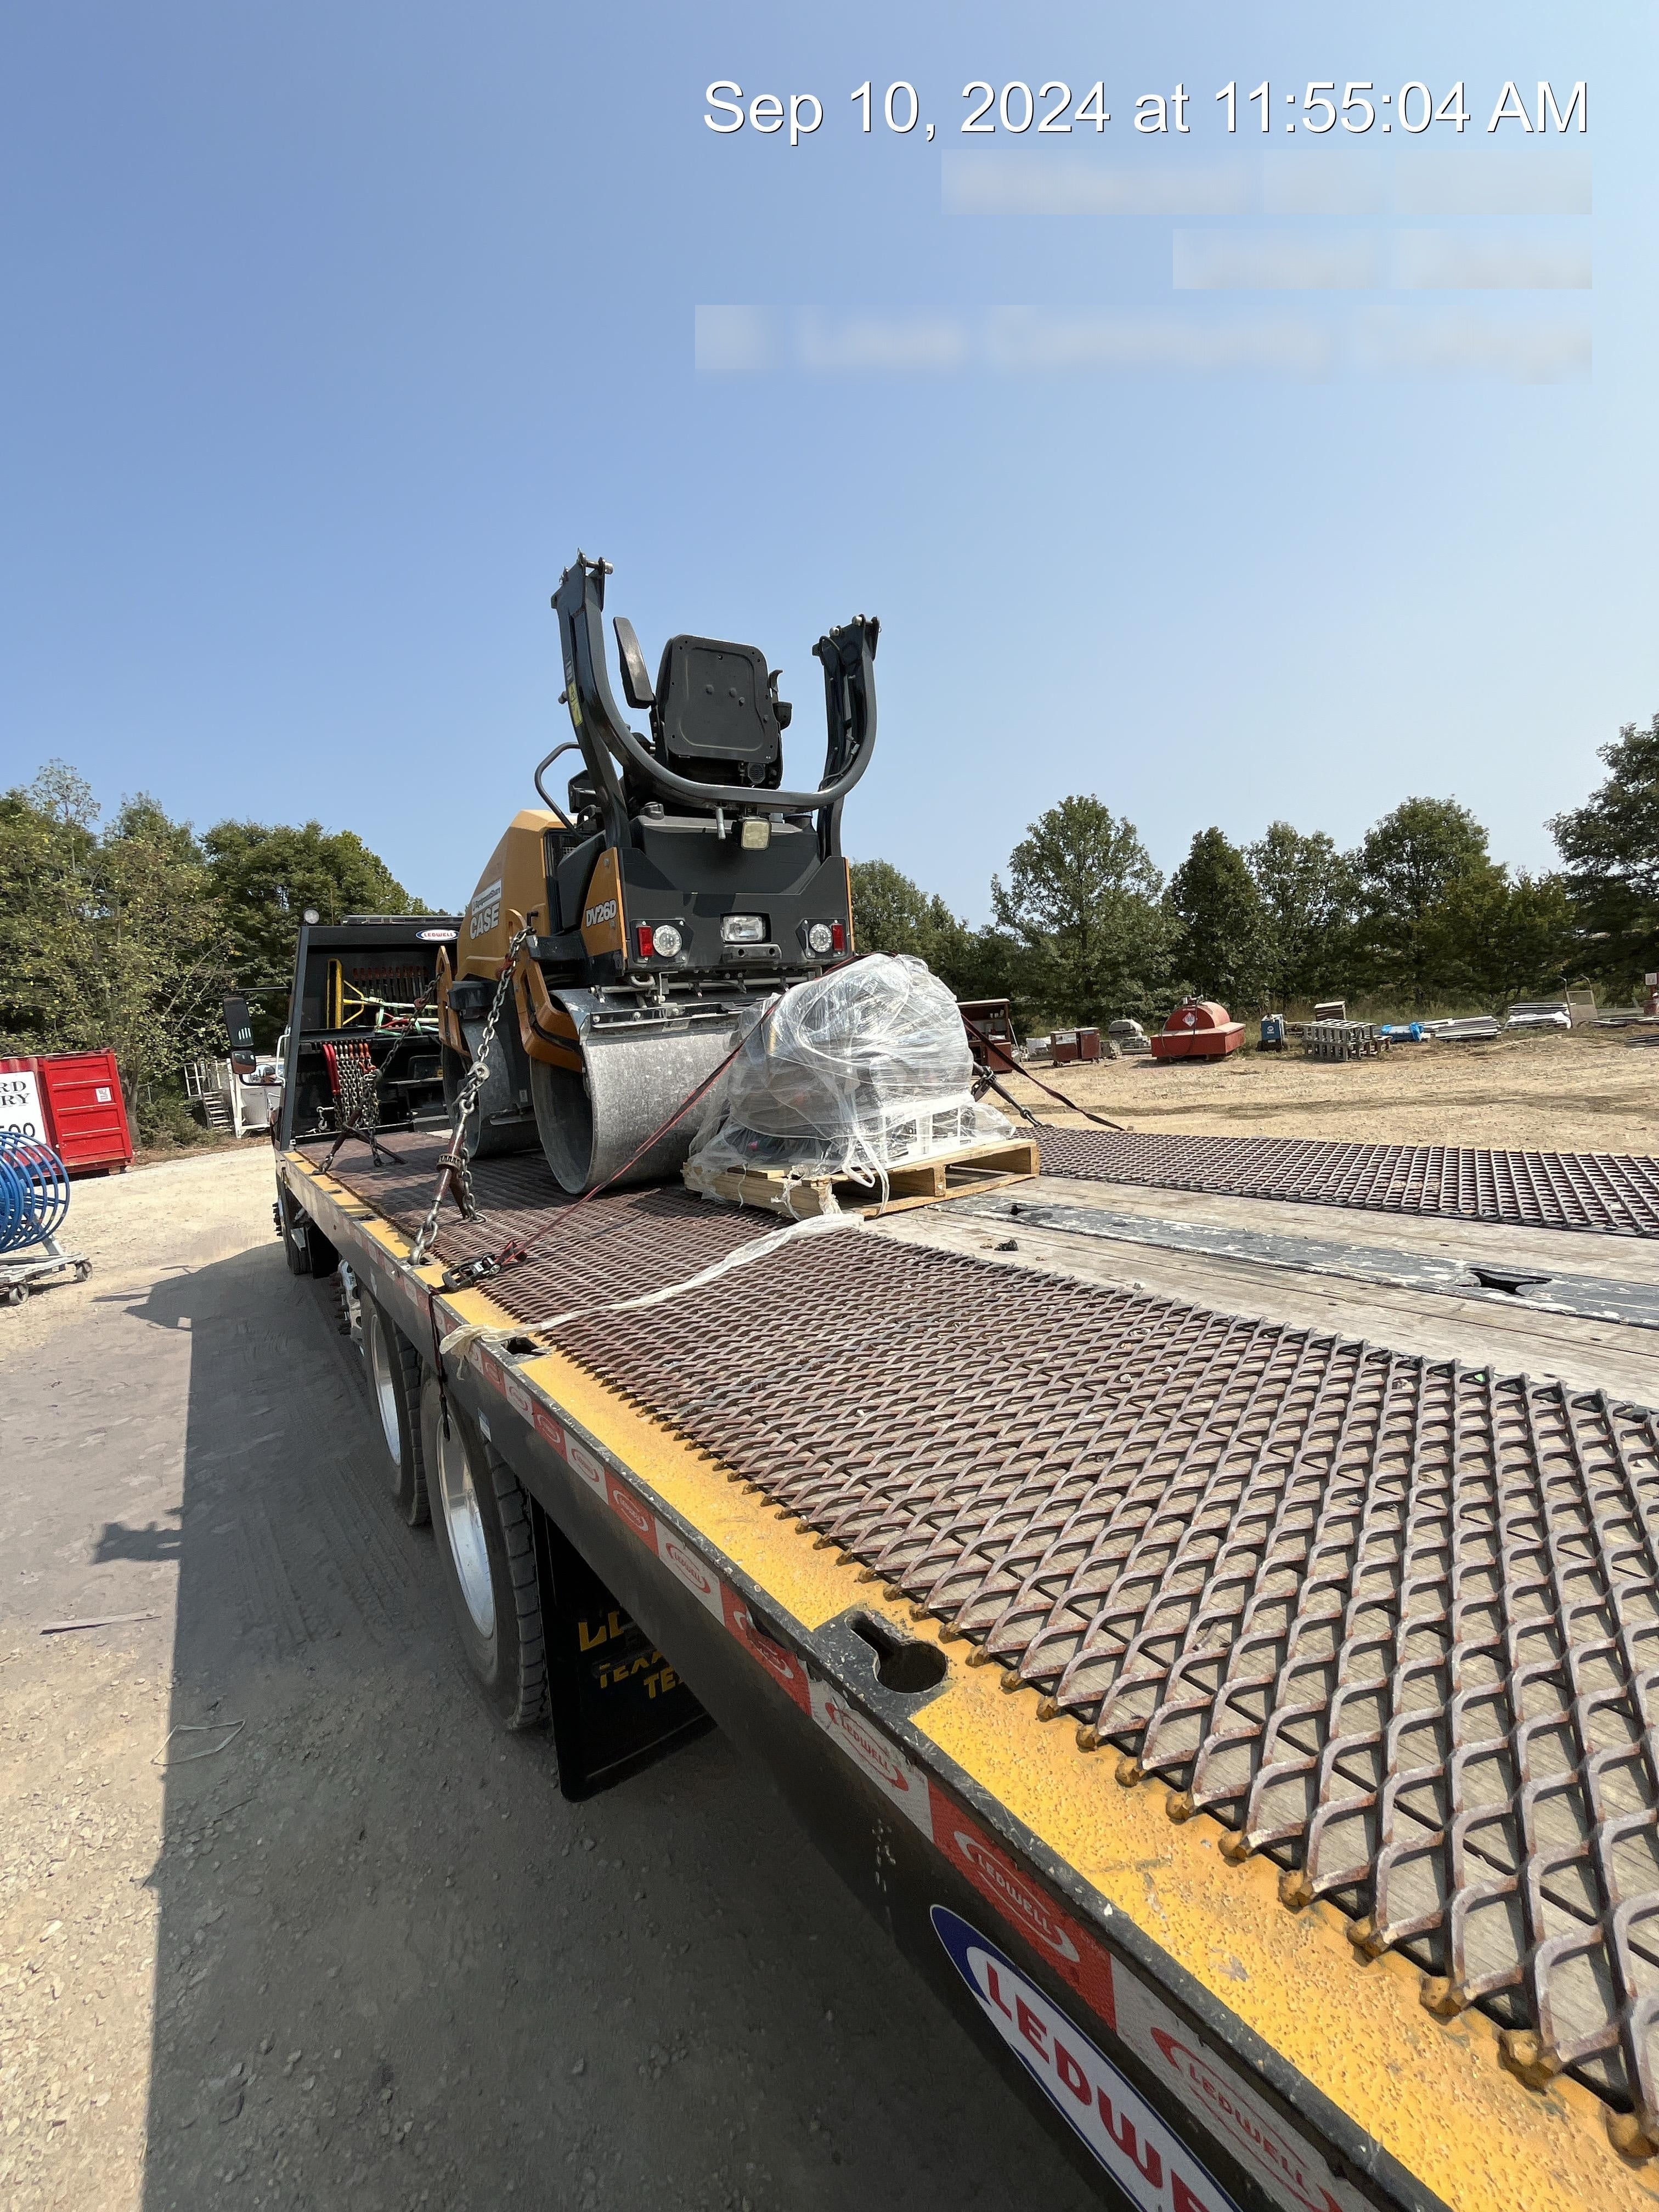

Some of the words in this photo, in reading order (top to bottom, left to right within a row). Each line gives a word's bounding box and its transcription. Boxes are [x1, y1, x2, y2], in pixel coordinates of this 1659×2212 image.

[470, 902, 500, 940] CASE
[586, 899, 617, 927] DV26D
[0, 1122, 35, 1138] 00
[643, 1664, 685, 1699] TE
[842, 1717, 890, 1773] LEDWELL
[978, 1853, 1051, 1934] LEDWELL
[1189, 2062, 1310, 2197] LEDWELL
